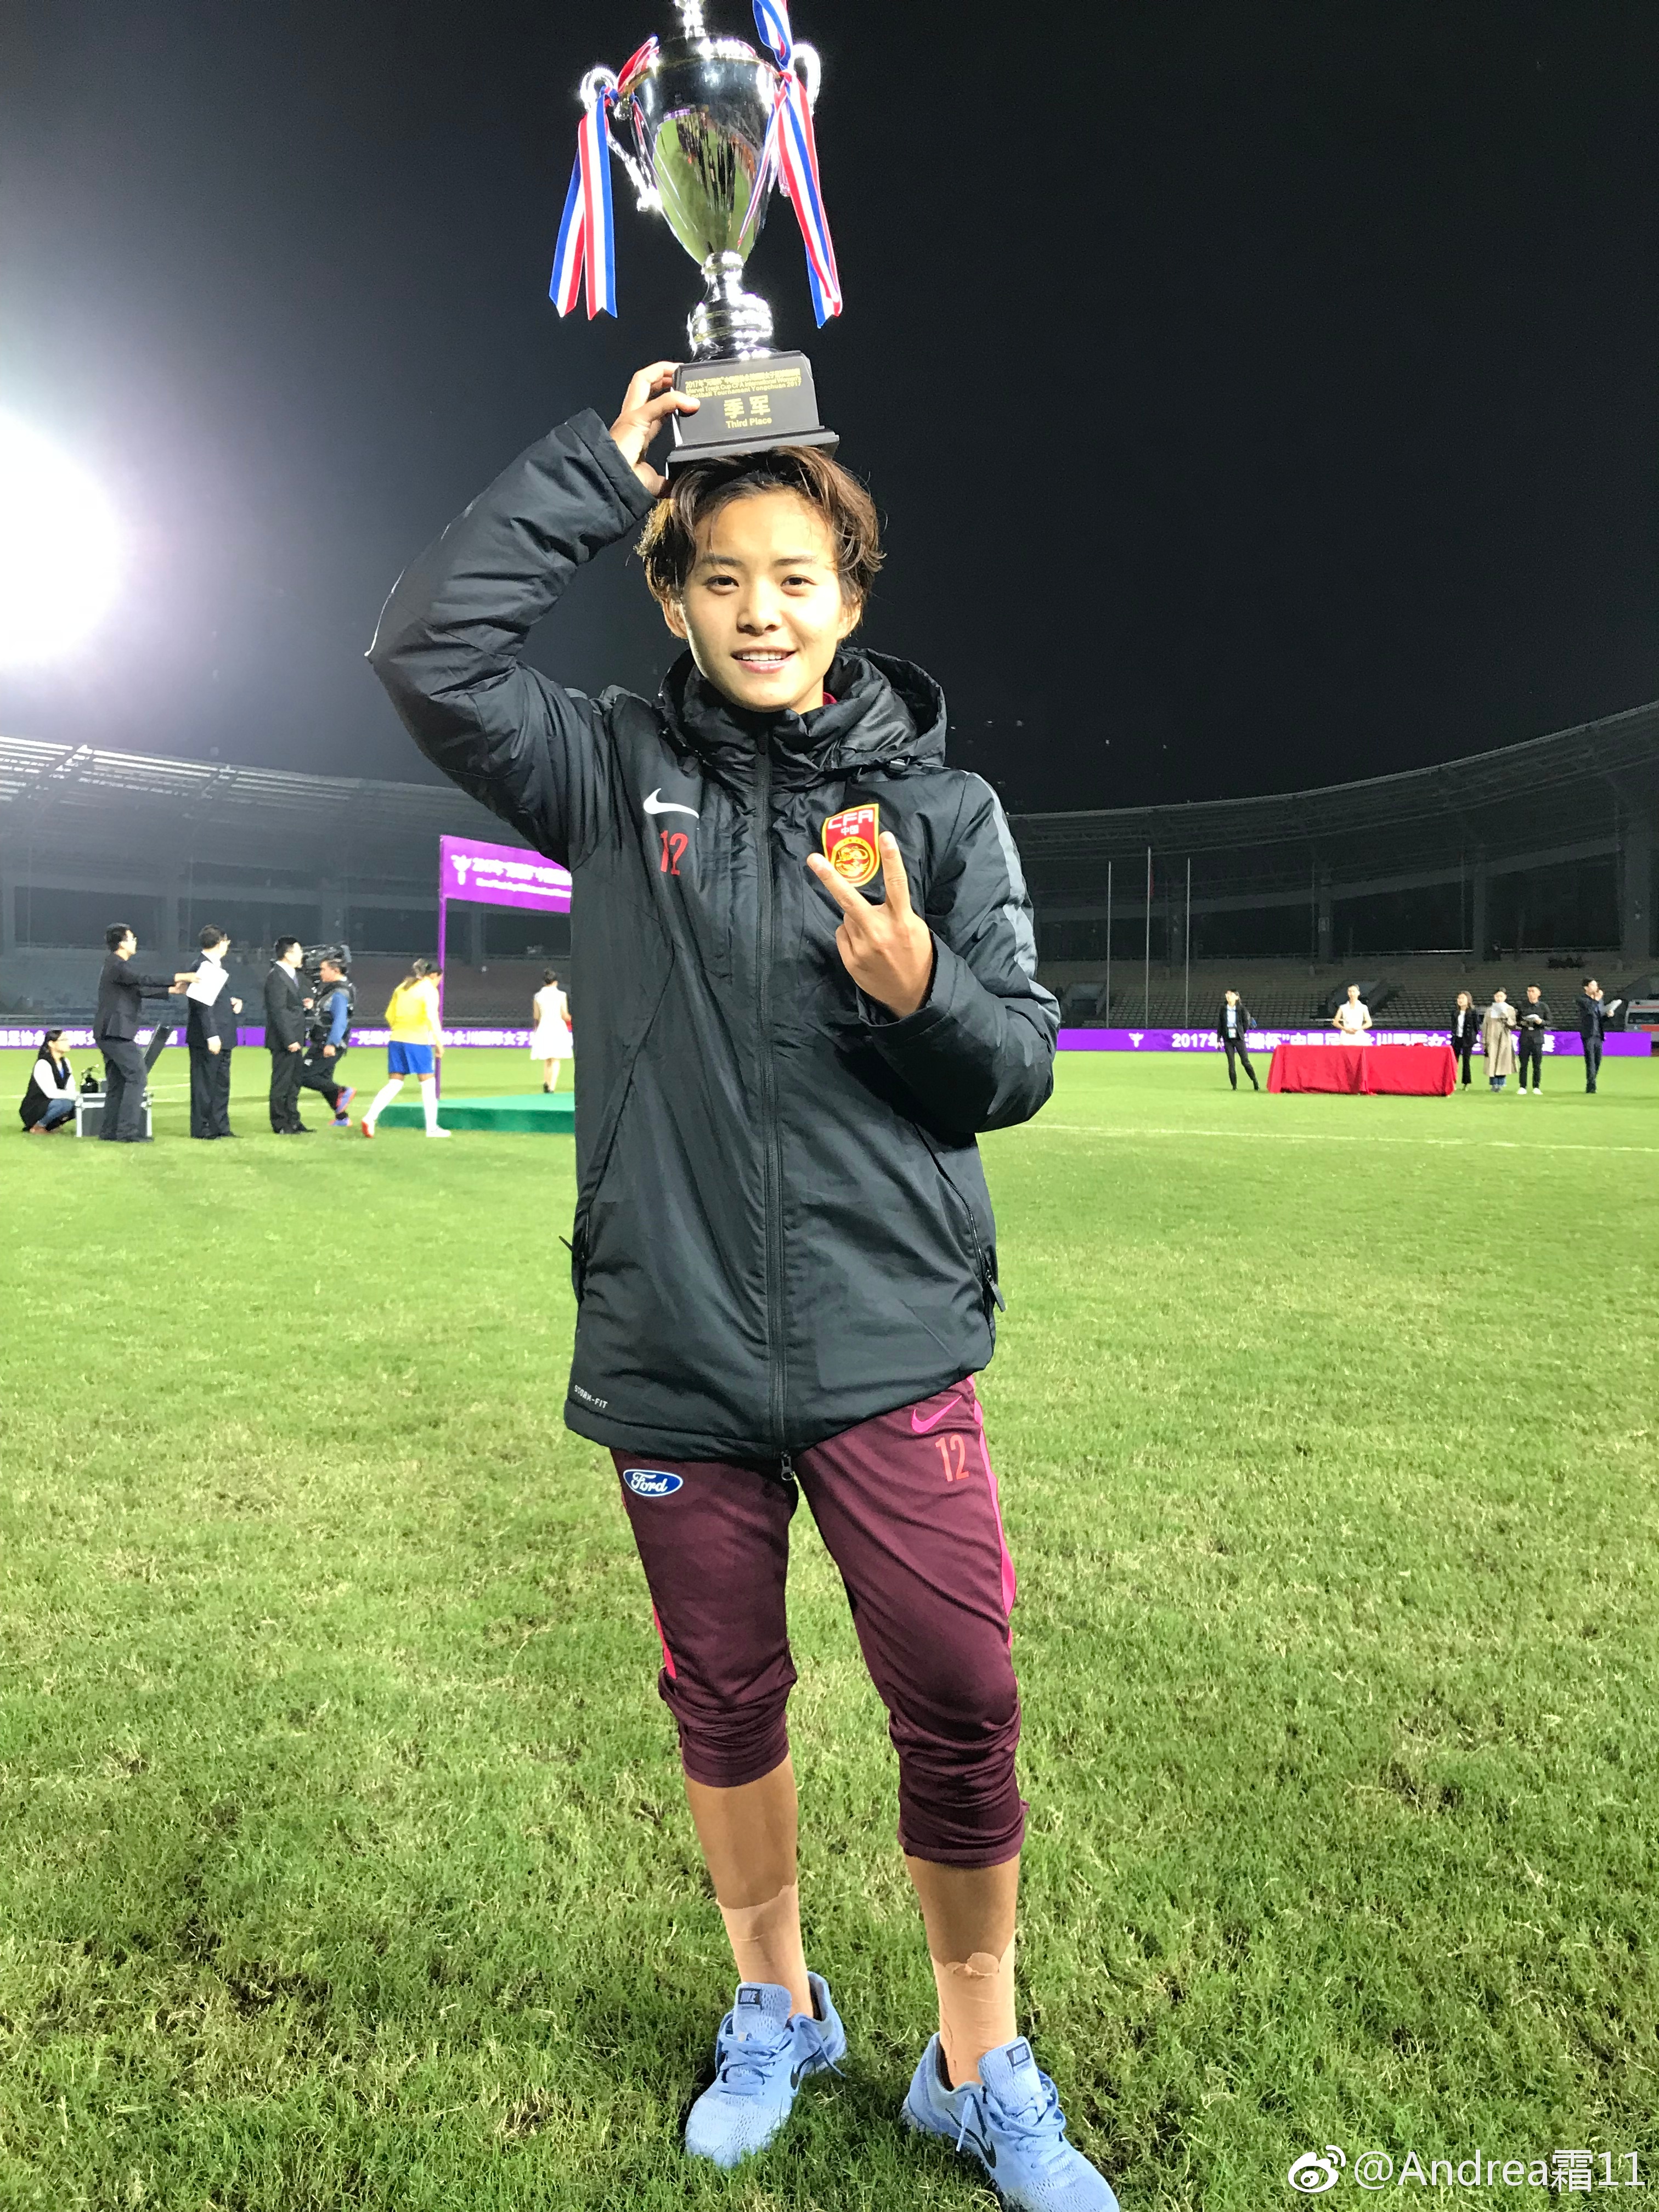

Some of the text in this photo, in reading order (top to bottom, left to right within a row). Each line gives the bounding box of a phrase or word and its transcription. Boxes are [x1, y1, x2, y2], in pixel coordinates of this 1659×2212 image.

[713, 386, 751, 396] Tournament
[751, 382, 786, 391] Yongchuan
[786, 380, 802, 388] 2017
[745, 377, 777, 387] International
[724, 394, 771, 419] 季军
[725, 417, 772, 428] Third Place
[827, 809, 873, 830] CFA
[840, 825, 860, 836] 中国
[660, 830, 689, 876] 12
[574, 1385, 608, 1409] STORM-FIT
[935, 1434, 970, 1482] 12
[631, 1472, 668, 1492] Ford
